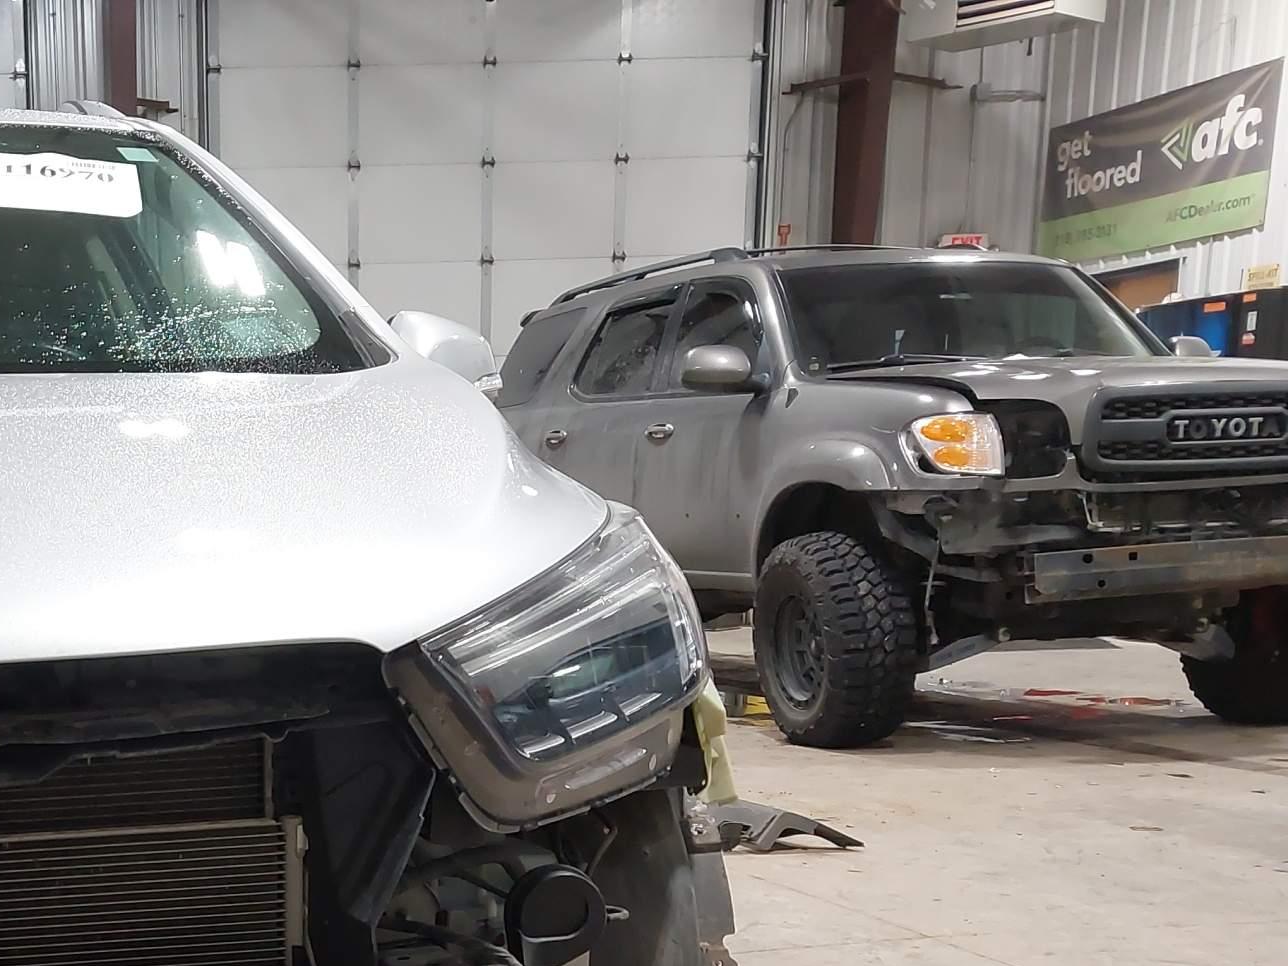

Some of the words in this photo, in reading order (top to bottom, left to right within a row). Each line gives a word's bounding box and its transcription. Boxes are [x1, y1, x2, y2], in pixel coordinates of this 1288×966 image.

[1056, 130, 1093, 171] get
[1191, 93, 1263, 163] afc
[1064, 150, 1143, 199] floored
[1174, 416, 1281, 440] TOYOTA
